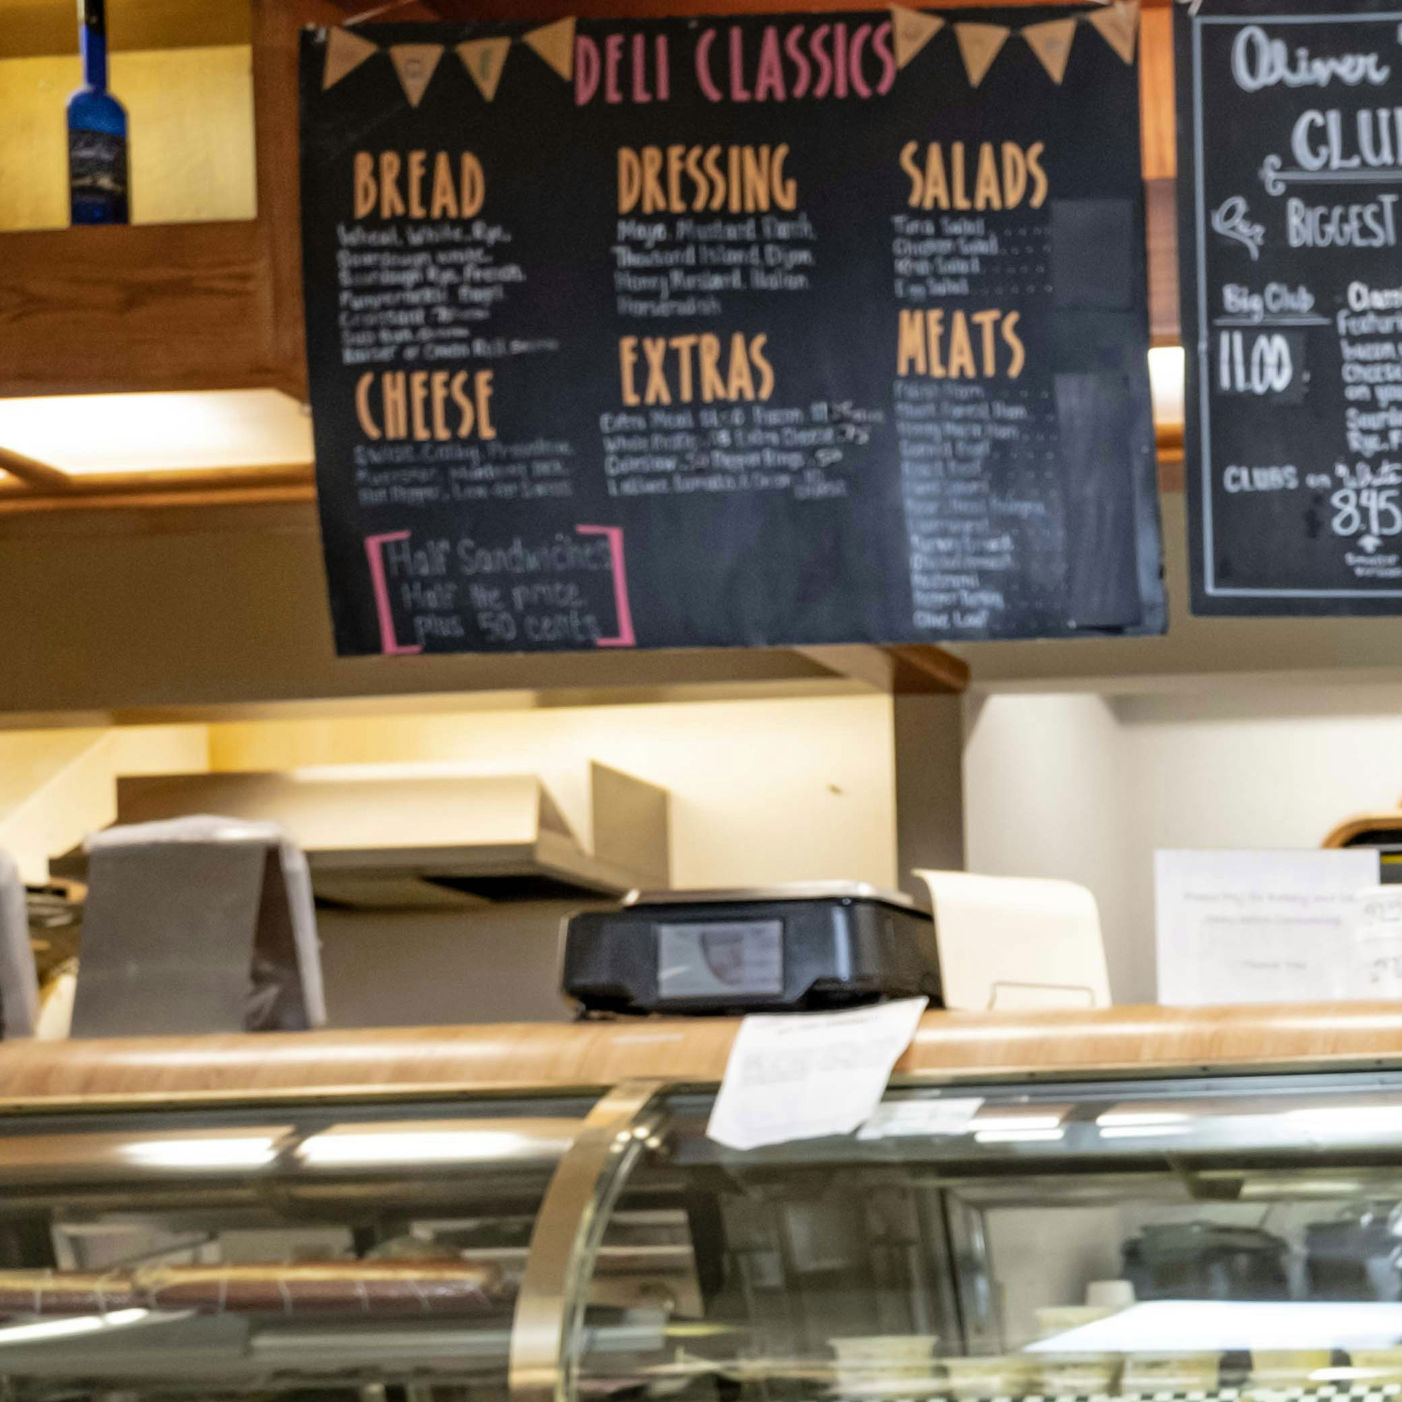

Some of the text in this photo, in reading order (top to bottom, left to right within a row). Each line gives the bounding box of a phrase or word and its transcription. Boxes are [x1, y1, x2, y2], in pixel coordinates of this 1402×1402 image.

[575, 21, 897, 106] DELI CLASSICS
[1232, 25, 1390, 93] Oliver
[354, 151, 485, 219] BREAD
[618, 143, 797, 214] DRESSING
[900, 140, 1048, 211] SALADS
[1286, 194, 1398, 247] BIGGEST
[1222, 283, 1263, 322] Big
[1265, 282, 1315, 313] Club
[620, 332, 774, 406] EXTRAS
[897, 308, 1025, 378] MEATS
[356, 370, 496, 440] CHEESE
[1223, 465, 1298, 493] CLUBS
